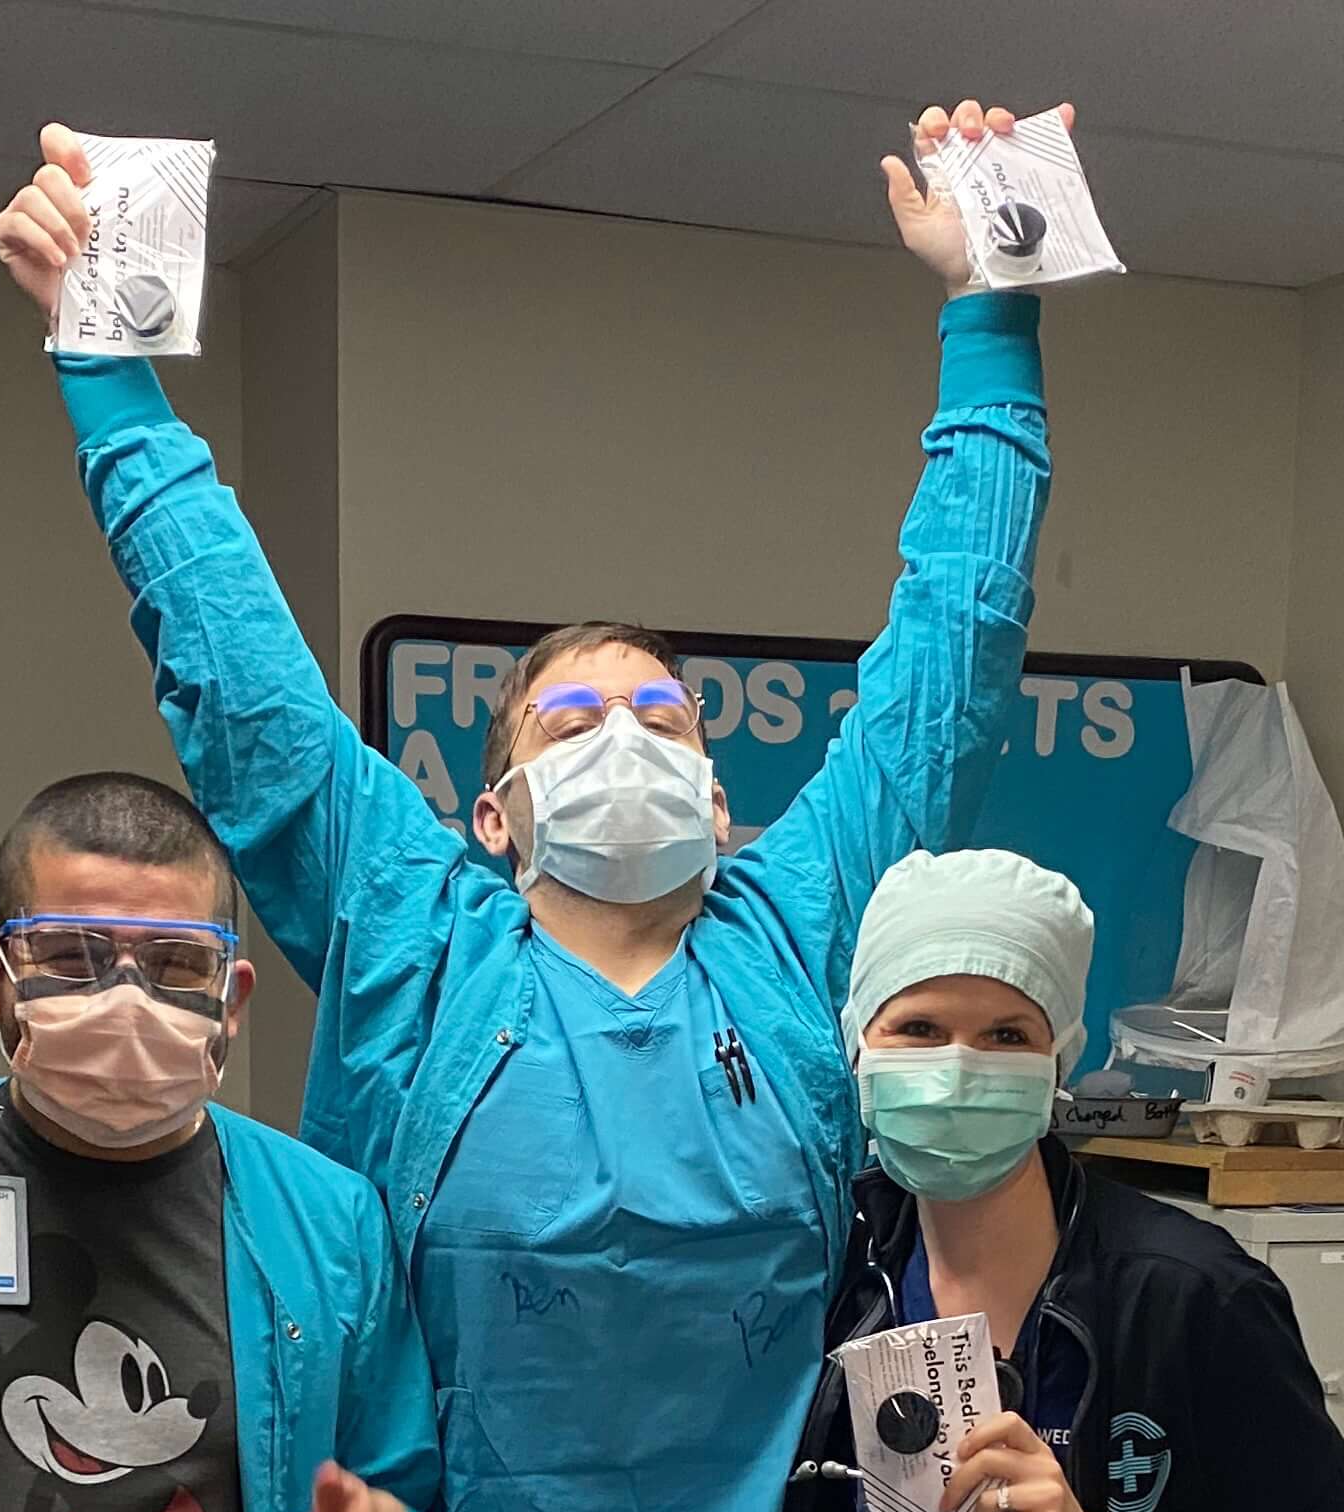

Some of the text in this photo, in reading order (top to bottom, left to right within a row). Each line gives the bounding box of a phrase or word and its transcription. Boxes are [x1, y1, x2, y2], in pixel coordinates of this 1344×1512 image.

[392, 643, 807, 745] FRDS
[951, 1331, 981, 1436] This Bedr
